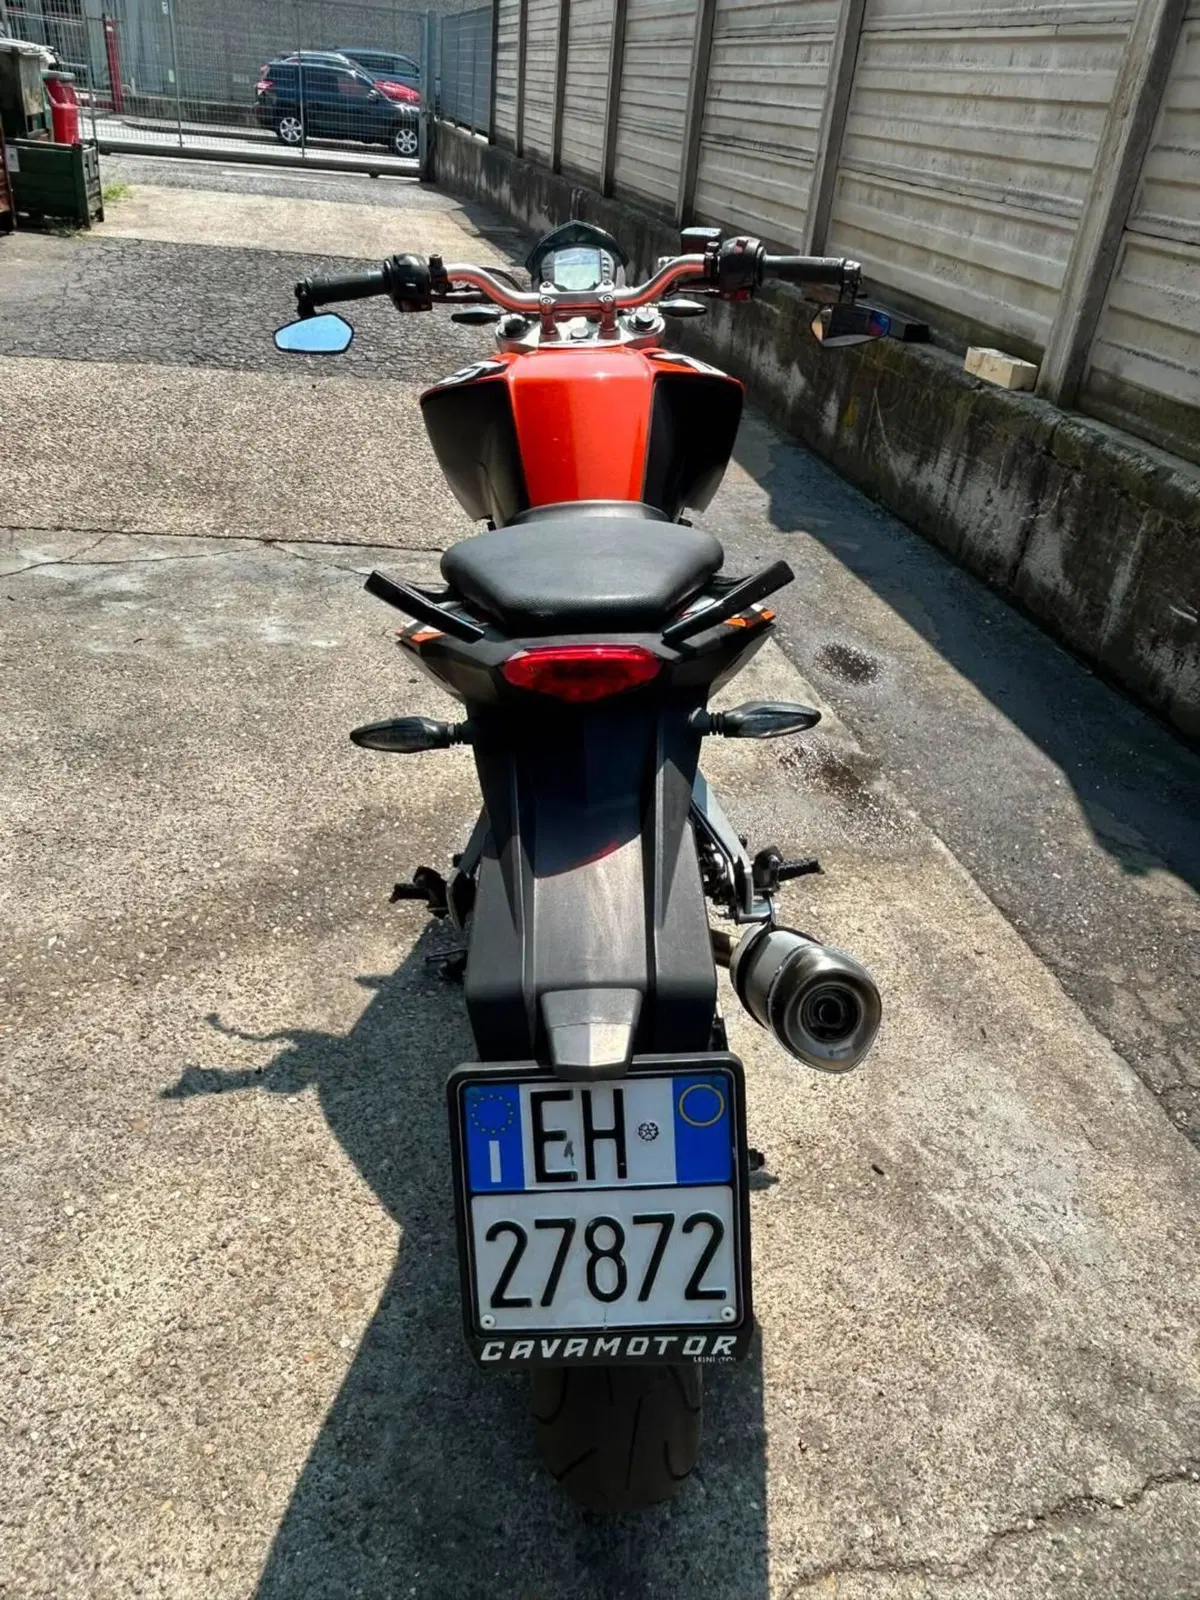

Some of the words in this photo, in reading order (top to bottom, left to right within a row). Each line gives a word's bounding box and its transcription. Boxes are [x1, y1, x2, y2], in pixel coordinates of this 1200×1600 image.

[489, 1140, 502, 1183] I
[529, 1087, 628, 1183] EH
[485, 1211, 727, 1309] 27872
[480, 1335, 737, 1361] CAVAMOTOR
